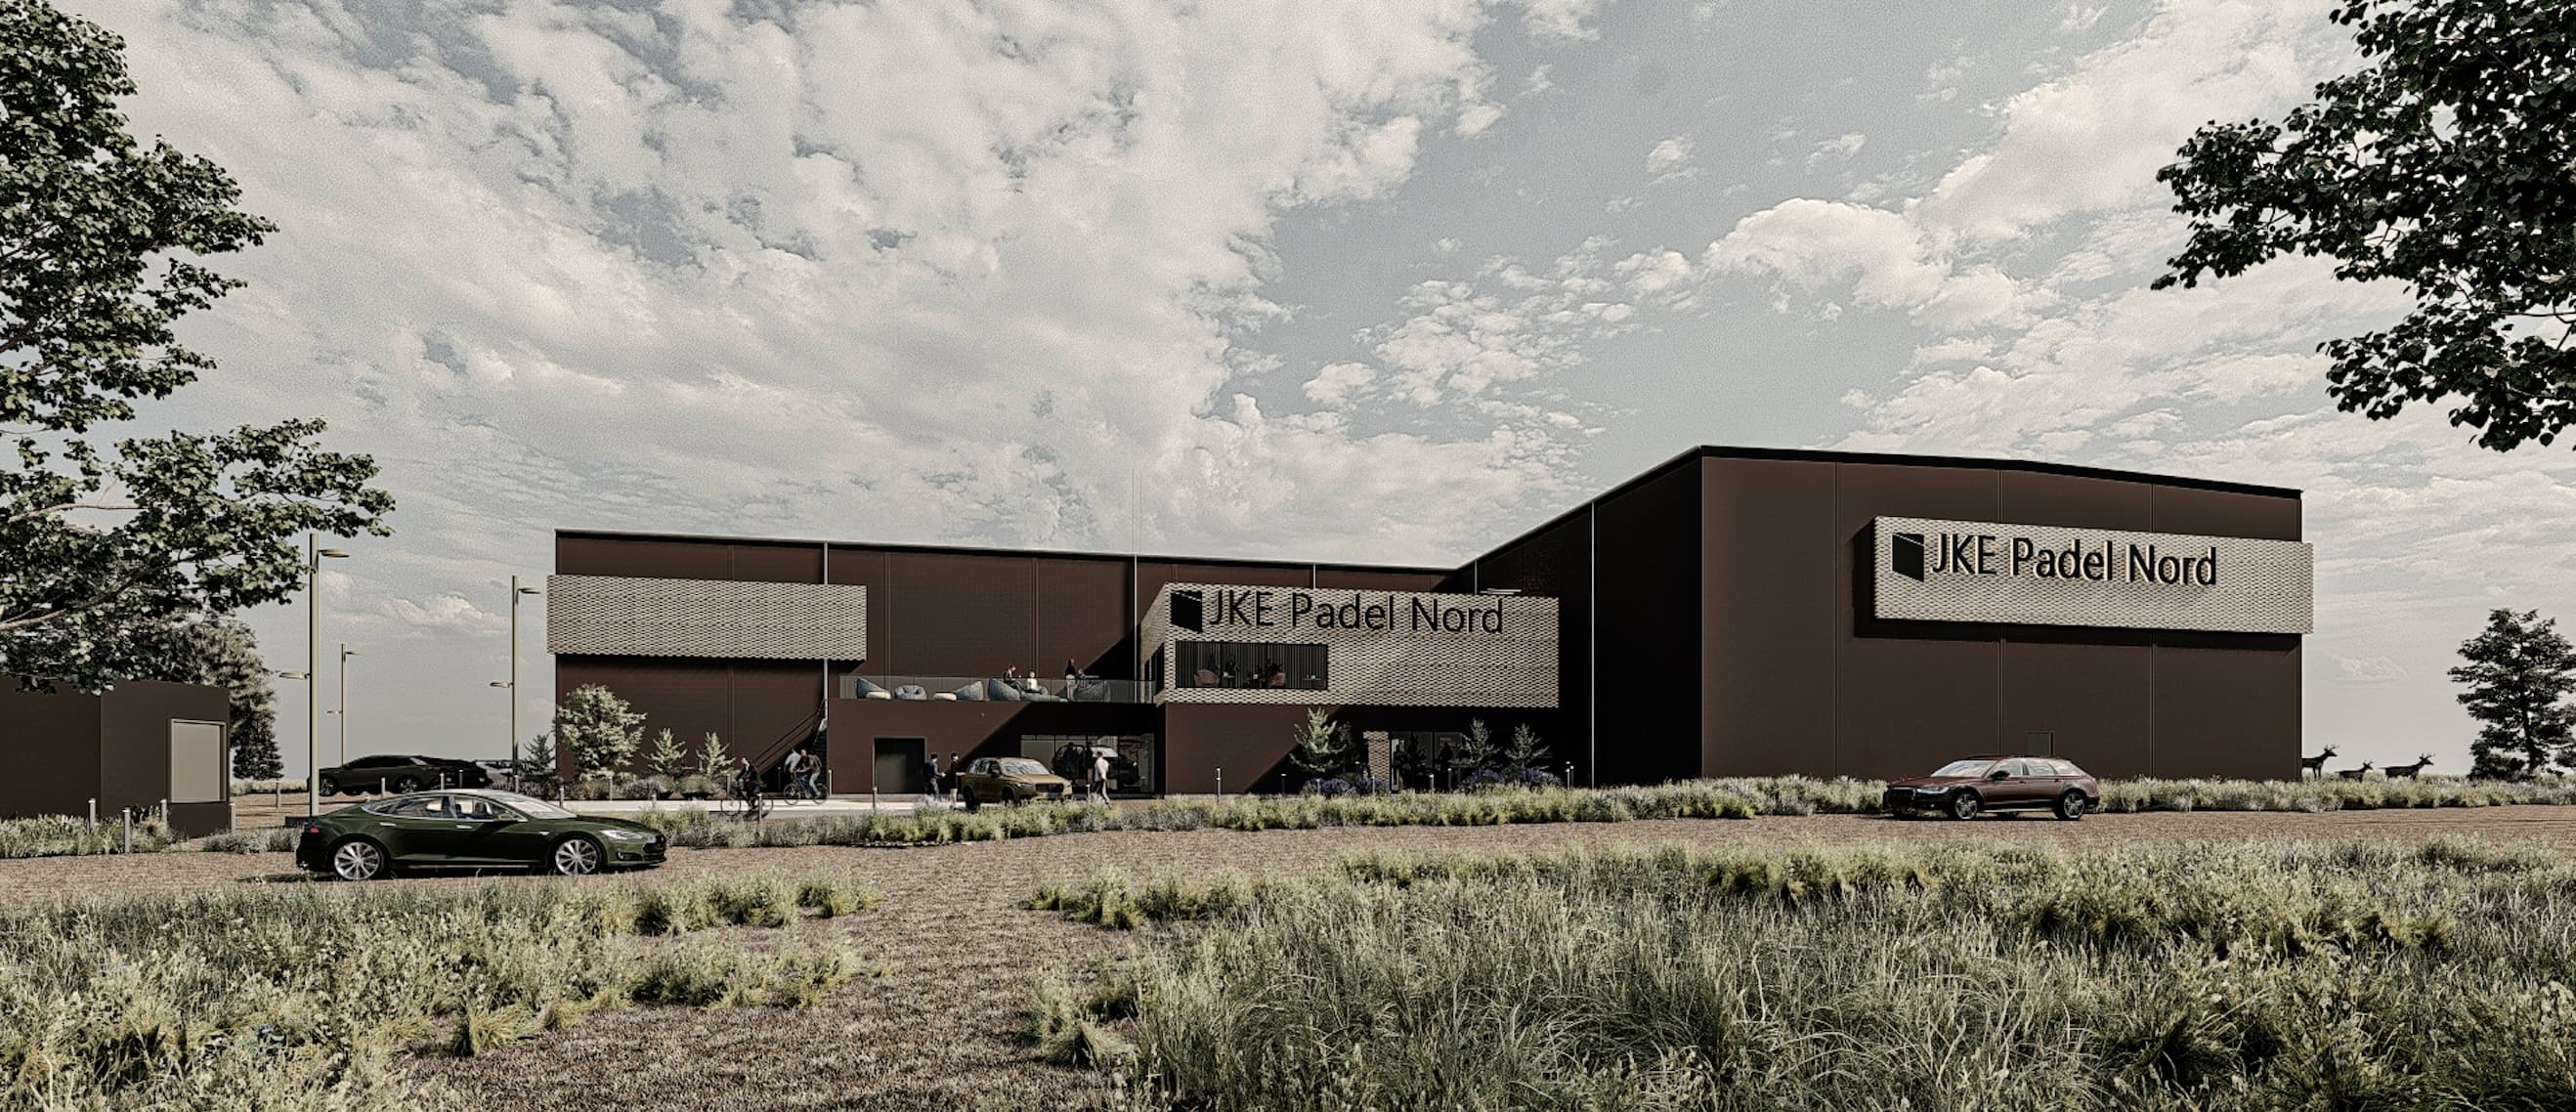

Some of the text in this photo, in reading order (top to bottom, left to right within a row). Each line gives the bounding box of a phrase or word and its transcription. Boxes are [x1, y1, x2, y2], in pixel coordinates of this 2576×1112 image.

[1931, 533, 2216, 586] JKE Padel Nord
[1209, 588, 1504, 634] JKE Padel Nord
